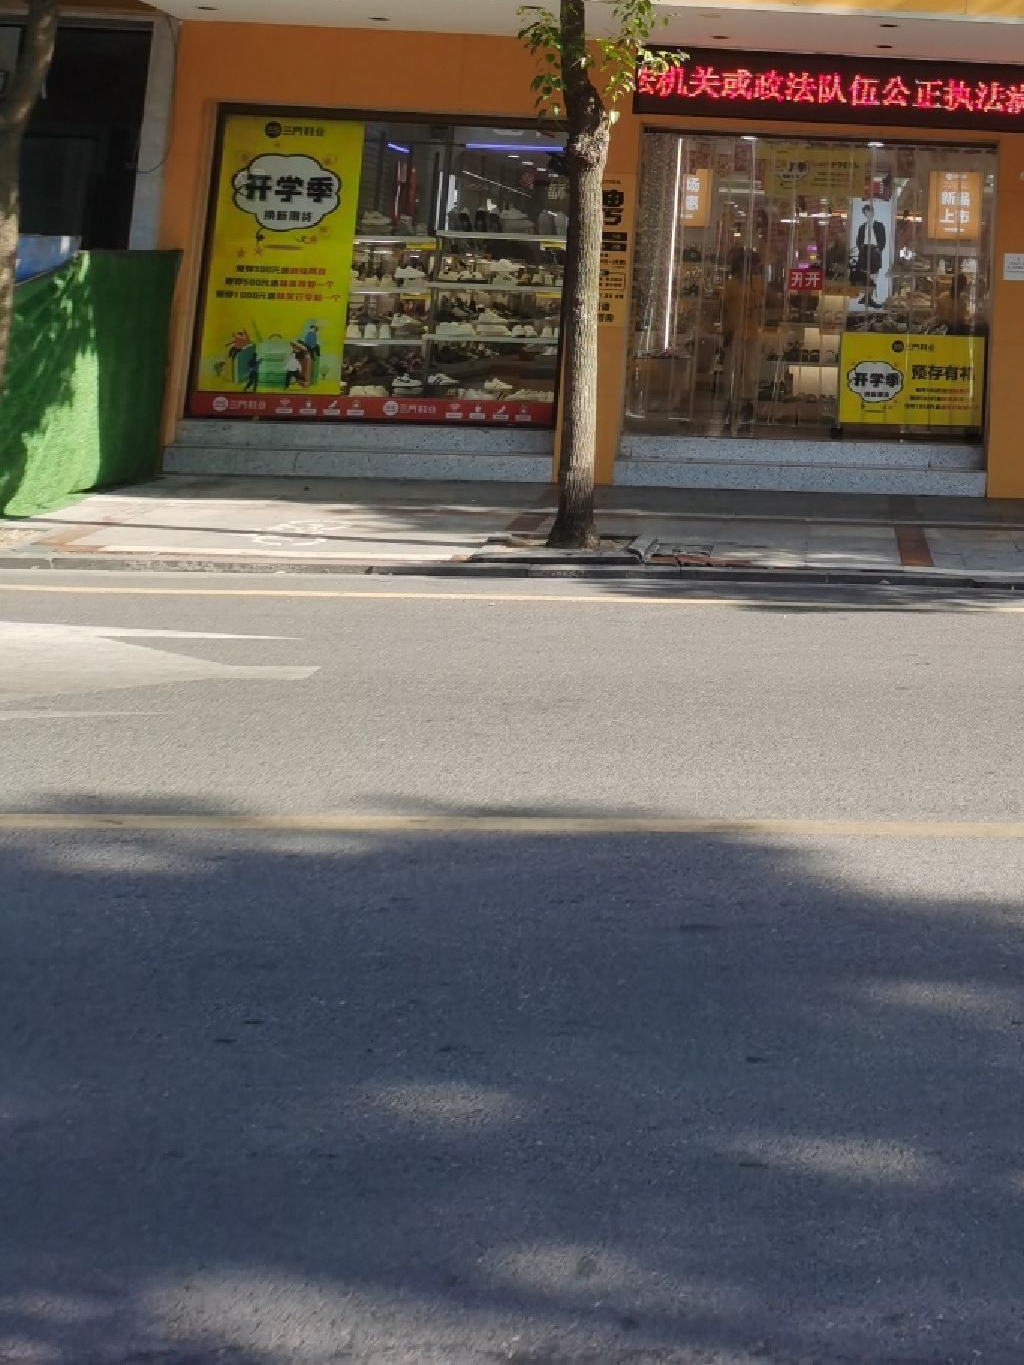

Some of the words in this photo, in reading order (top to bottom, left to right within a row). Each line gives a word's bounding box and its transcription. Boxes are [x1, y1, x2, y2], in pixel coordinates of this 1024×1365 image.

[246, 174, 335, 203] 开学季
[853, 372, 899, 389] 开学季
